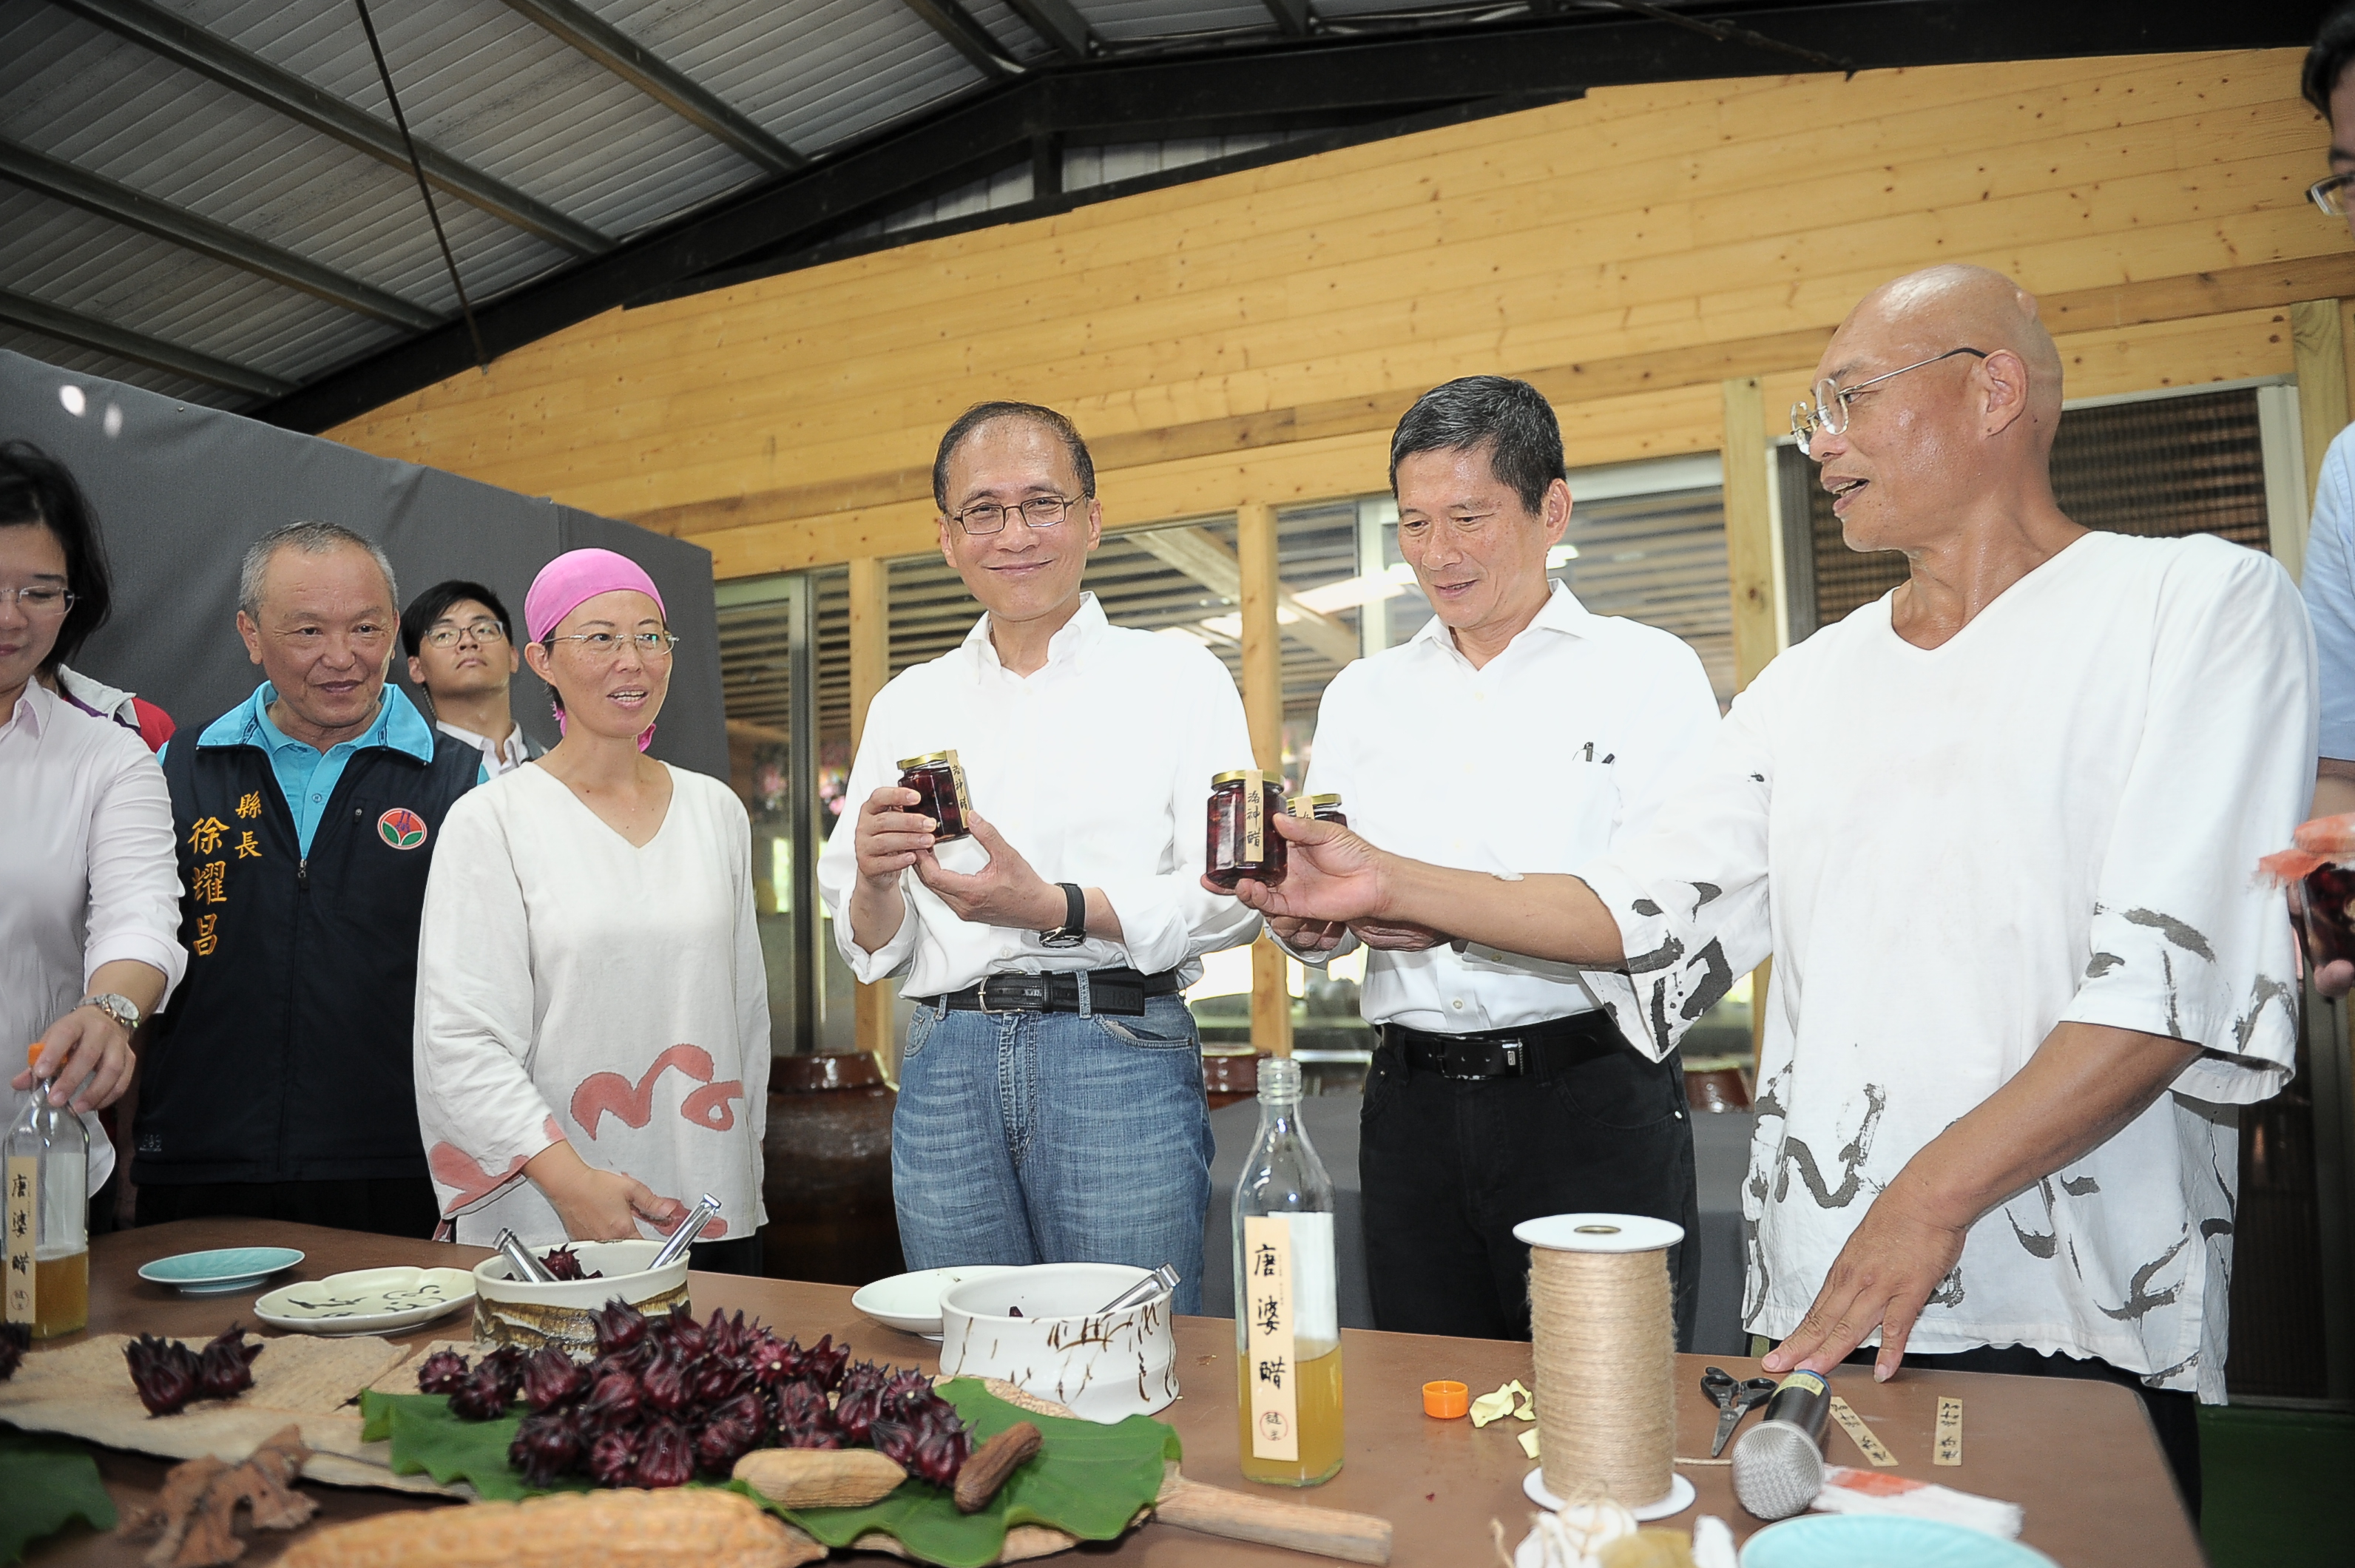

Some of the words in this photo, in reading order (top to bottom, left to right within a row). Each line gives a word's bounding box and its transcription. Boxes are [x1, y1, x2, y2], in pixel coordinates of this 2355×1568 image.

[234, 791, 262, 859] 縣長
[1246, 791, 1261, 847] 洛神醋
[188, 817, 229, 956] 徐耀昌
[12, 1174, 30, 1275] 唐婆醋
[1254, 1244, 1286, 1390] 唐婆醋
